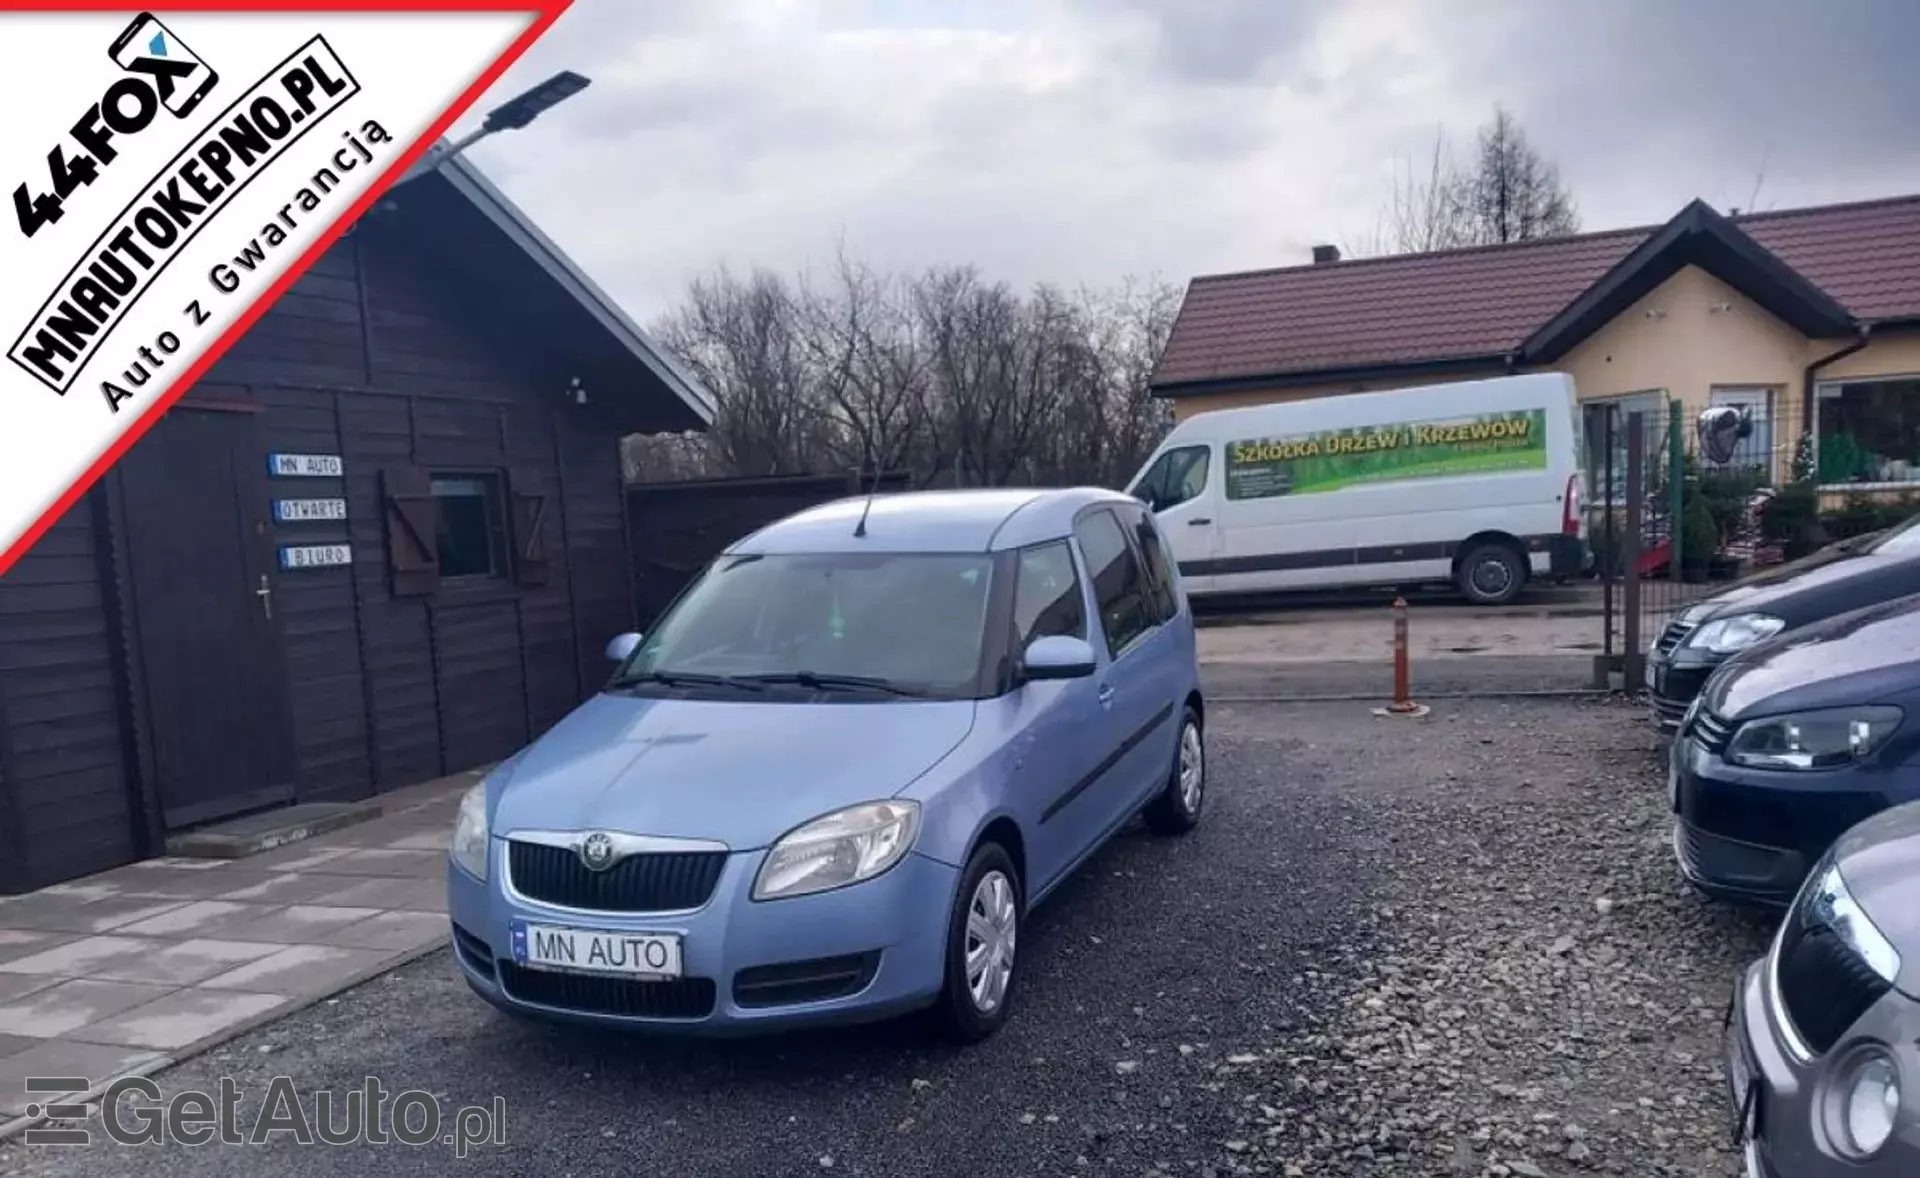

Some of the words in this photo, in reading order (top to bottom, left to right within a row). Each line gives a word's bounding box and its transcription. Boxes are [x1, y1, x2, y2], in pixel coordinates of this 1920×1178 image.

[1326, 432, 1398, 454] DRZEW
[280, 458, 297, 472] MN
[307, 458, 339, 473] AUTO
[283, 501, 345, 518] OTWARTE
[294, 549, 345, 566] BIURO
[535, 931, 576, 962] MN
[588, 936, 669, 969] AUTO
